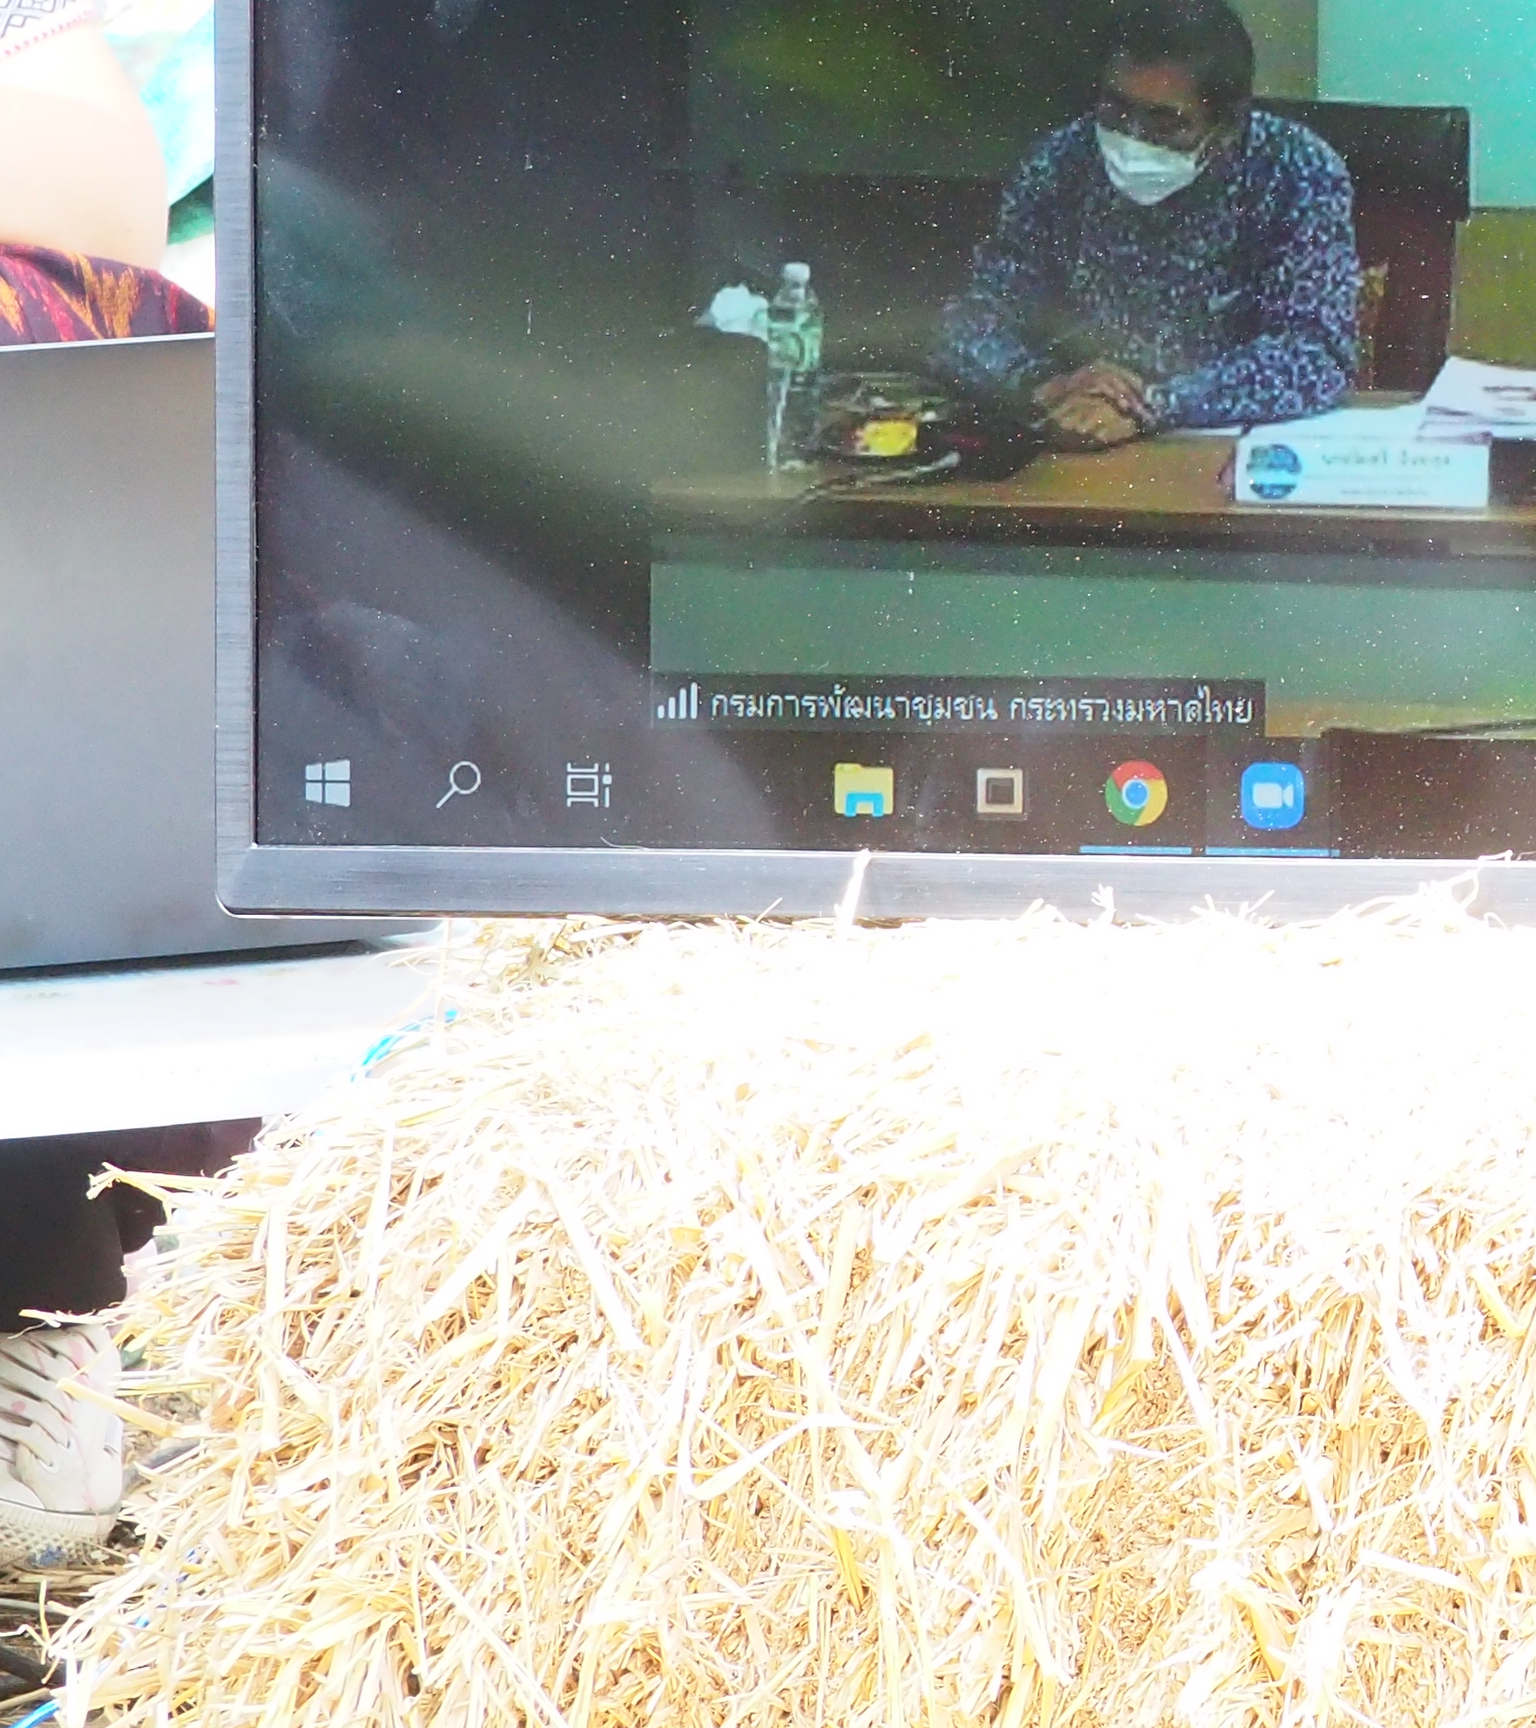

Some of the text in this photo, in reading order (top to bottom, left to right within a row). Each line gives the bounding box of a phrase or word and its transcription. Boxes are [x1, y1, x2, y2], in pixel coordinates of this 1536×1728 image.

[710, 683, 1254, 727] กรมการพัฒนาชุมชน กระทรวงมหาดไทย
